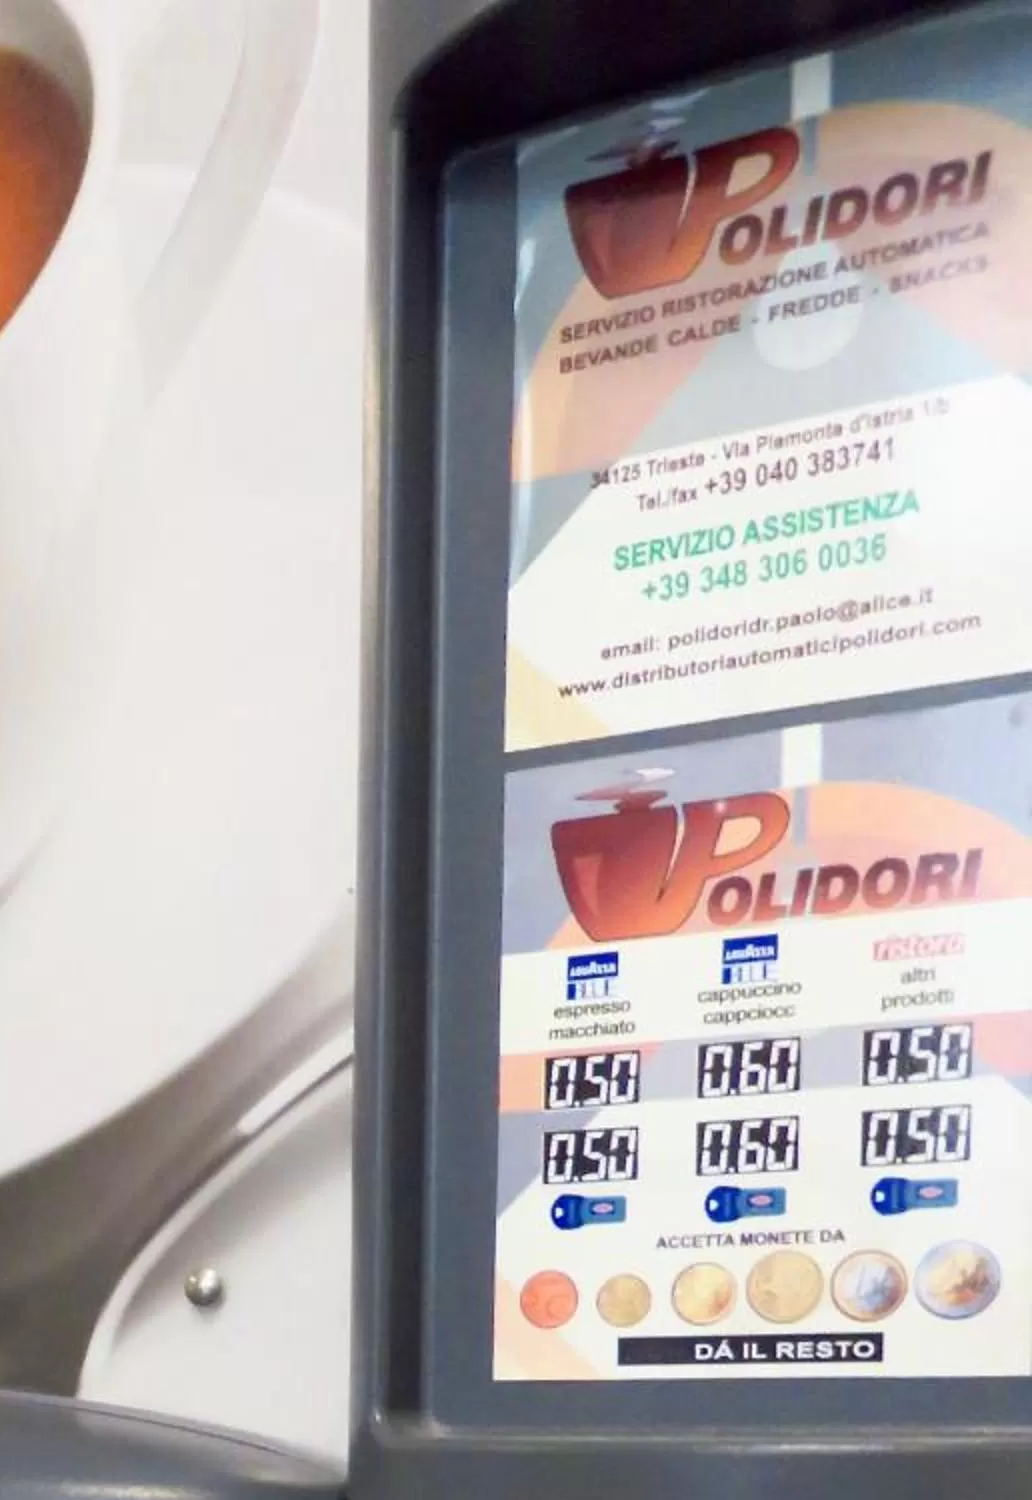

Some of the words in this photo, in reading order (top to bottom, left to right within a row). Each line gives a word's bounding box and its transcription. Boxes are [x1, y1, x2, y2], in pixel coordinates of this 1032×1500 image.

[672, 126, 994, 268] POLIDORI
[559, 305, 656, 345] SERVIZIO
[661, 259, 827, 318] RISTORAZIONE
[833, 221, 991, 275] AUTOMATICA
[559, 334, 658, 375] BEVANDE
[667, 315, 741, 347] CALDE
[768, 286, 862, 323] FREDDE
[889, 255, 991, 295] SNACKS
[647, 450, 706, 476] Trieste
[722, 440, 750, 460] Via
[756, 420, 844, 454] Piemonte
[704, 466, 748, 495] +39
[755, 456, 799, 488] 040
[807, 436, 894, 478] 383741
[613, 525, 736, 572] SERVIZIO
[742, 489, 921, 546] ASSISTENZA
[641, 571, 690, 602] +39
[700, 559, 749, 594] 348
[759, 549, 808, 583] 306
[817, 533, 887, 572] 0036
[600, 637, 661, 661] email:
[666, 791, 985, 928] POLIDORI
[697, 980, 803, 1006] cappuccino
[881, 989, 955, 1011] prodotti
[900, 966, 936, 985] altri
[549, 1020, 636, 1041] macchiato
[553, 1000, 631, 1020] espresso
[548, 1052, 639, 1108] 0.50
[701, 1038, 798, 1098] 0.60
[867, 1023, 971, 1085] 0.50
[547, 1128, 637, 1183] 0.50
[700, 1116, 797, 1175] 0.60
[866, 1106, 969, 1166] 0.50
[656, 1231, 735, 1249] ACCETTA
[740, 1230, 815, 1246] MONETE
[820, 1229, 846, 1243] DA
[743, 1342, 767, 1359] IL
[775, 1340, 876, 1360] RESTO
